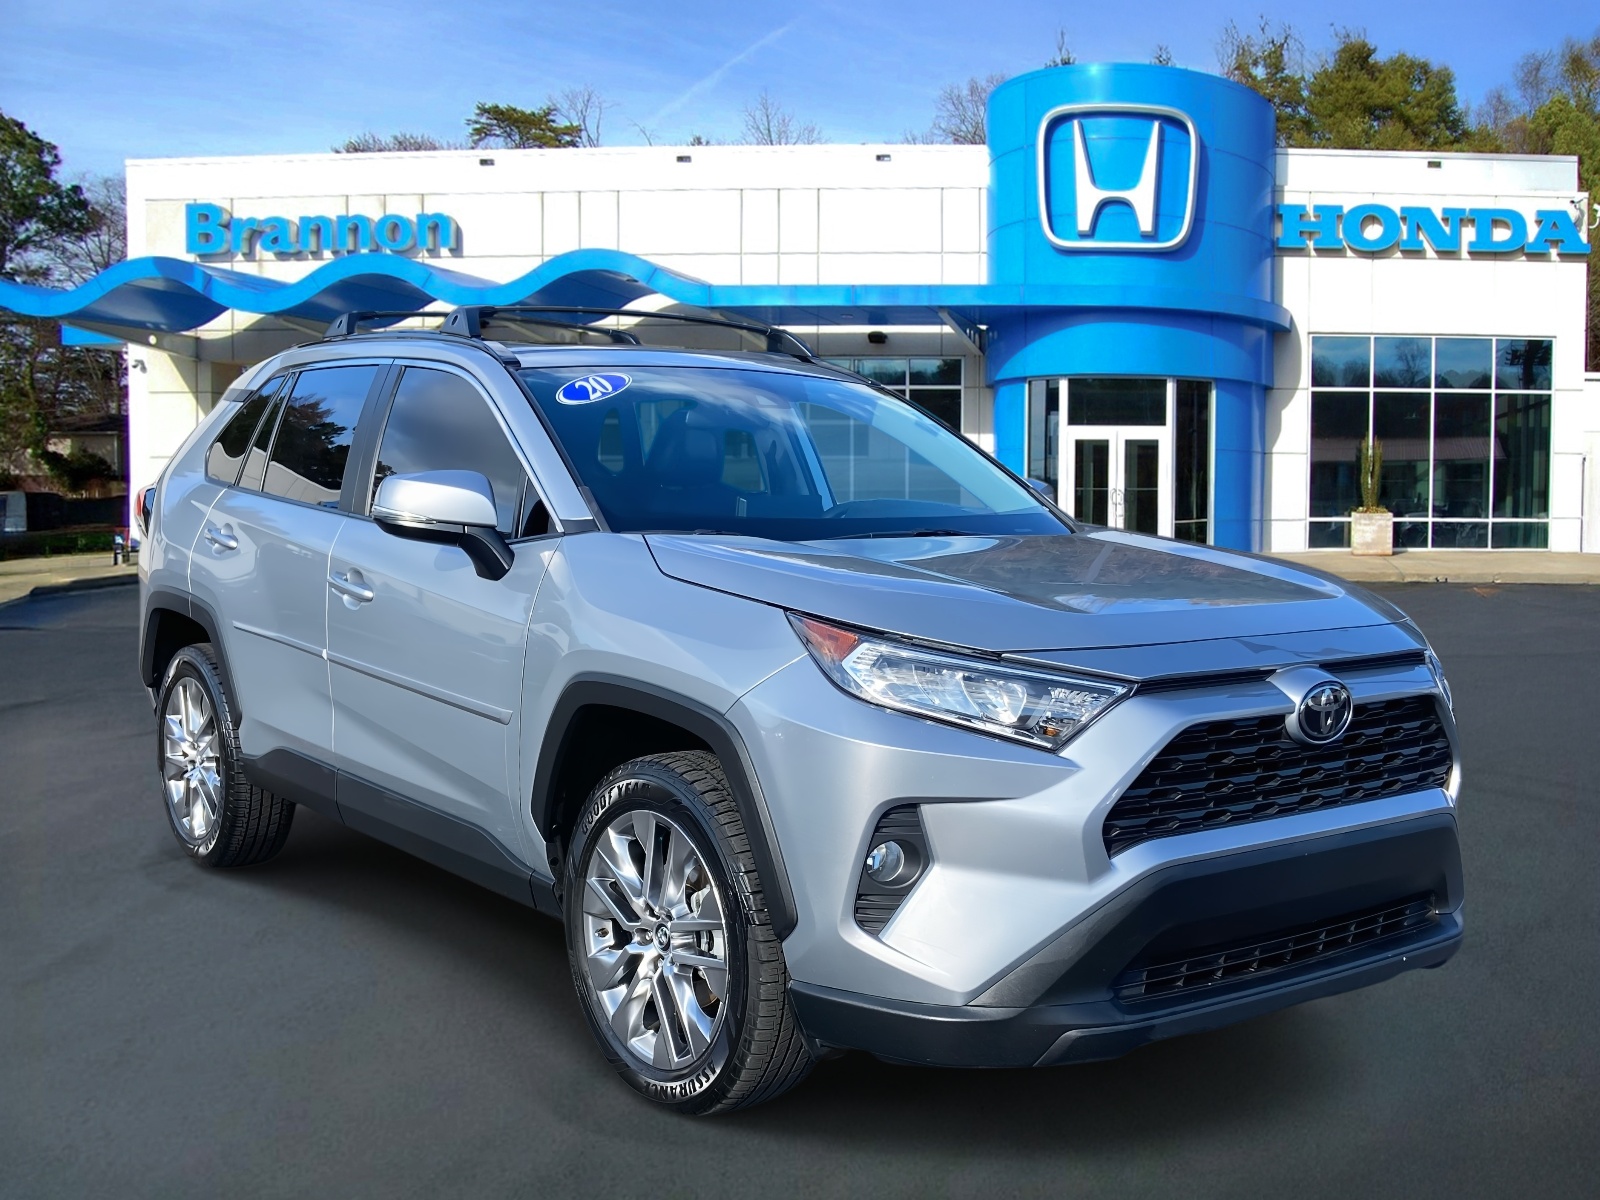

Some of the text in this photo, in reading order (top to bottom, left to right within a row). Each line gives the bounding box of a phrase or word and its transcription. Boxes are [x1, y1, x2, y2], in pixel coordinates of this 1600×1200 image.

[185, 202, 457, 255] Brannon
[1277, 203, 1591, 254] HONDA
[575, 376, 613, 401] 20
